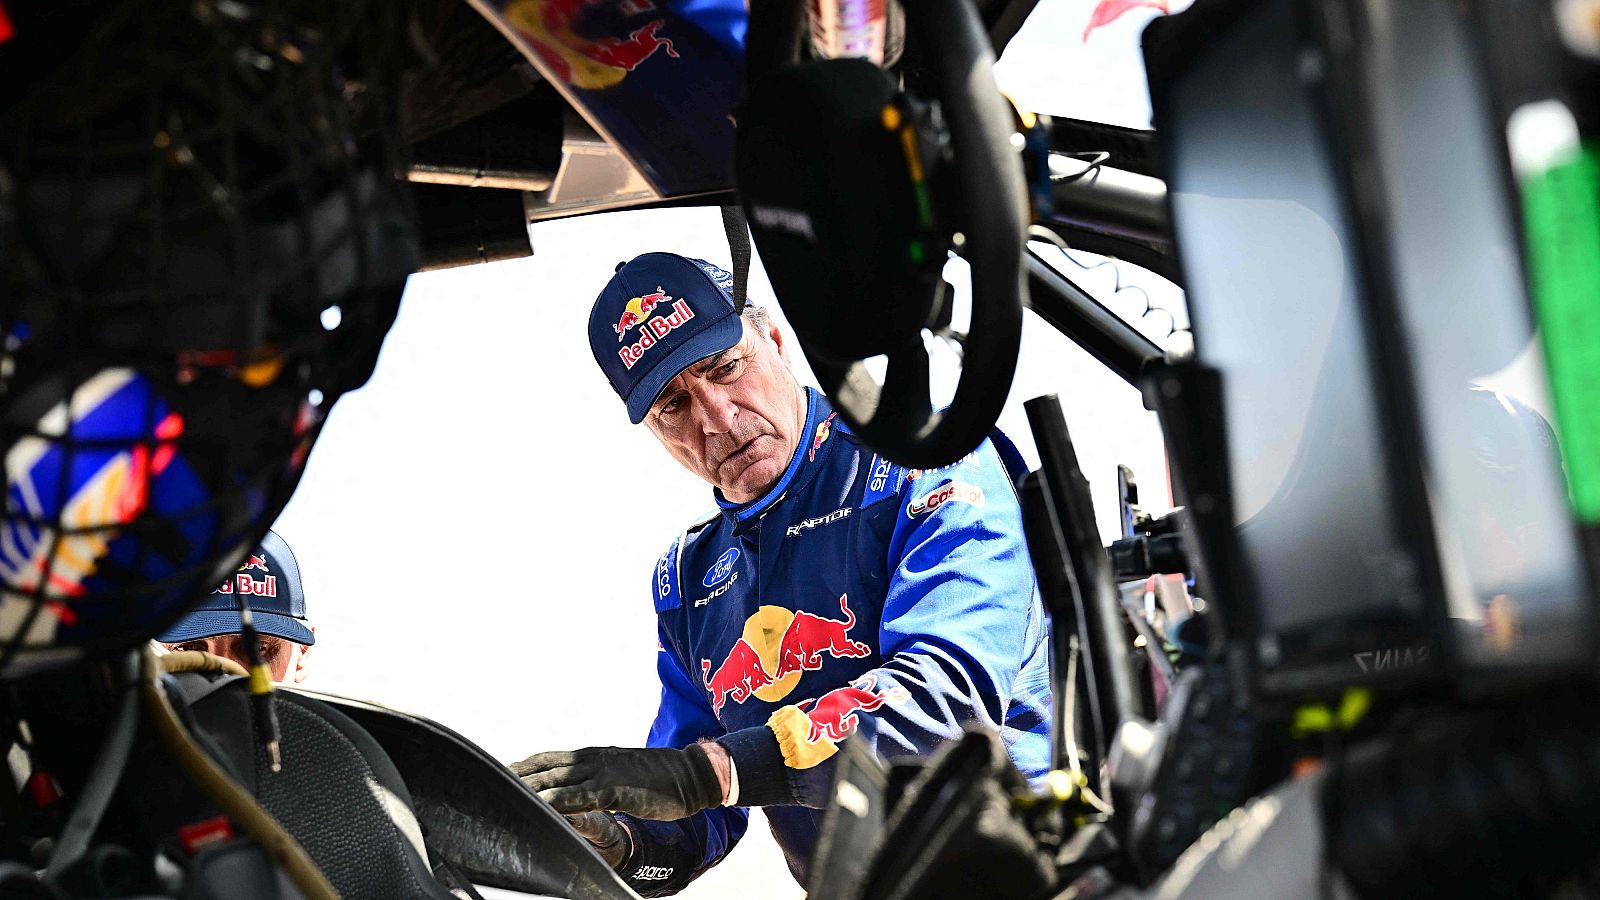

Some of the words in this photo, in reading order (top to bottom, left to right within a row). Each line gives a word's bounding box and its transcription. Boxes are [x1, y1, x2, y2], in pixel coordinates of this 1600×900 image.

[618, 324, 658, 371] Red
[647, 297, 696, 340] Bull
[870, 457, 891, 492] sp
[237, 573, 276, 598] Bull
[658, 555, 672, 598] arco
[711, 553, 735, 583] Ford
[694, 571, 739, 608] RACING
